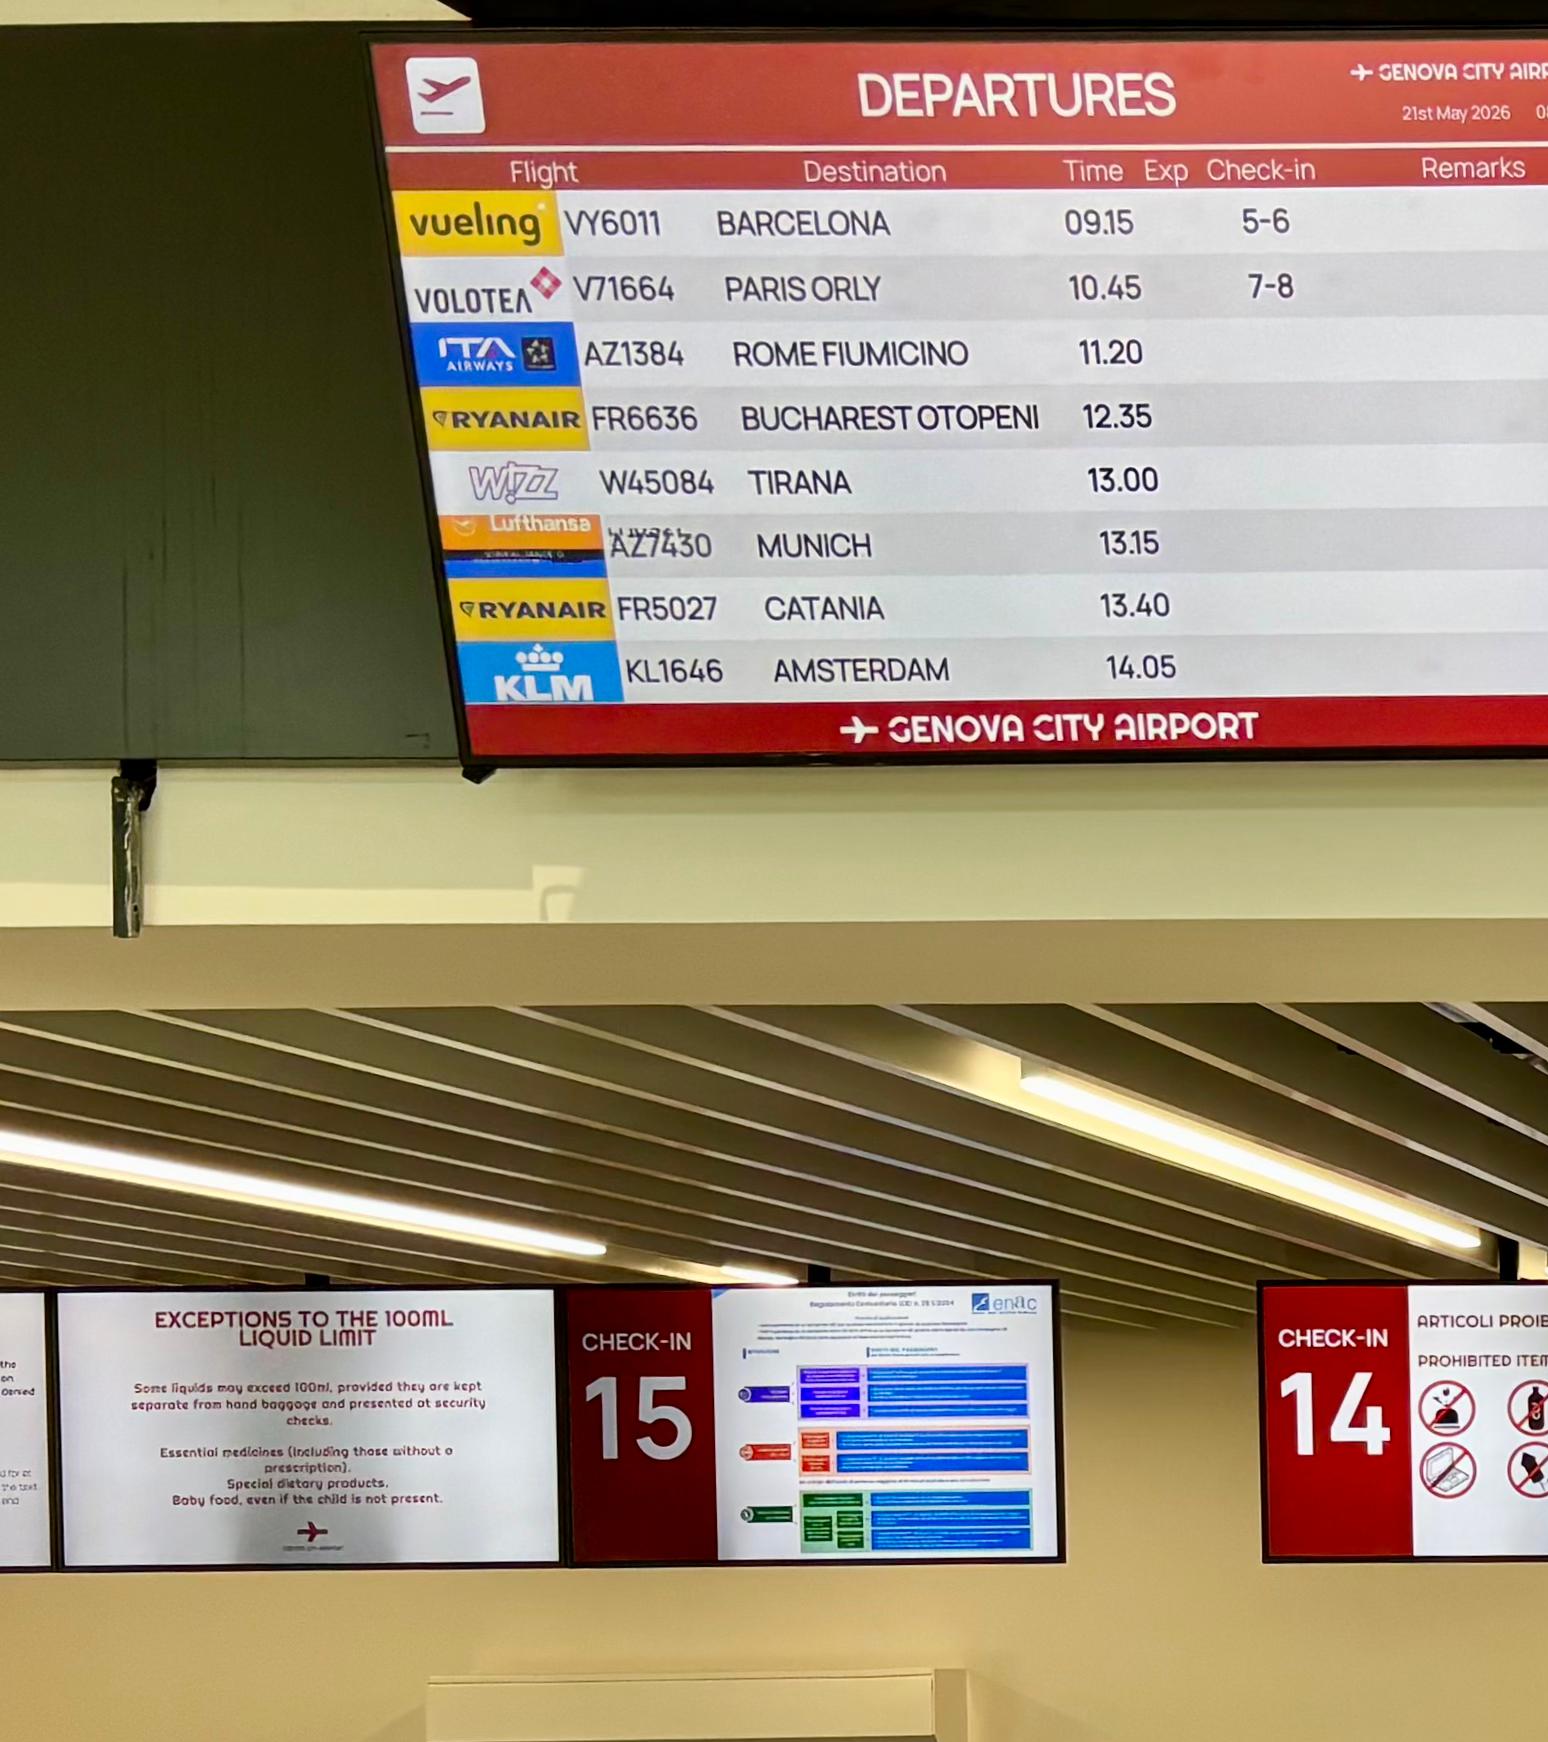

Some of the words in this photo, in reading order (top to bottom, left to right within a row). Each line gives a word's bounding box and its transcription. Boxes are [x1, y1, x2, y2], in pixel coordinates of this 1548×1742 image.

[1379, 64, 1457, 80] GENOVA
[1463, 63, 1504, 80] CITY
[858, 72, 1176, 117] DEPARTURES
[1402, 105, 1433, 122] 21st
[1437, 106, 1467, 123] May
[1471, 105, 1510, 120] 2026
[510, 161, 579, 190] Flight
[804, 160, 946, 182] Destination
[1063, 160, 1123, 181] Time
[1145, 160, 1188, 187] Exp
[1207, 159, 1315, 180] Check-in
[1422, 157, 1525, 178] Remarks
[410, 202, 540, 246] vueling
[564, 210, 659, 235] VY6011
[718, 211, 890, 236] BARCELONA
[1066, 210, 1133, 235] 09.15
[1243, 208, 1289, 233] 5-6
[415, 288, 532, 313] VOLOTEA
[573, 276, 674, 300] V71664
[725, 276, 806, 301] PARIS
[812, 276, 880, 301] ORLY
[1070, 275, 1141, 300] 10.45
[1249, 273, 1293, 298] 7-8
[439, 337, 515, 358] ITA
[585, 341, 683, 366] AZ1384
[733, 342, 817, 366] ROME
[823, 341, 968, 366] FIUMICINO
[1080, 340, 1142, 364] 11.20
[447, 361, 513, 373] AIRWAYS
[452, 411, 580, 428] RYANAIR
[593, 406, 697, 430] FR6636
[742, 406, 912, 430] BUCHAREST
[918, 405, 1038, 430] OTOPENI
[1084, 404, 1151, 428] 12.35
[600, 470, 714, 494] W45084
[748, 470, 852, 494] TIRANA
[1088, 467, 1158, 492] 13.00
[610, 533, 713, 558] AZ7430
[757, 533, 871, 557] MUNICH
[1100, 531, 1159, 554] 13.15
[479, 602, 606, 618] RYANAIR
[618, 597, 716, 620] FR5027
[765, 596, 884, 620] CATANIA
[1101, 593, 1169, 617] 13.40
[494, 675, 593, 701] KLM
[626, 659, 723, 682] KL1646
[775, 658, 949, 682] AMSTERDAM
[1107, 655, 1176, 679] 14.05
[1418, 1315, 1493, 1328] ARTICOLI
[583, 1332, 691, 1351] CHECK-IN
[1279, 1329, 1388, 1347] CHECK-IN
[1419, 1355, 1511, 1367] PROHIBITED
[586, 1376, 692, 1460] 15
[1281, 1372, 1390, 1455] 14
